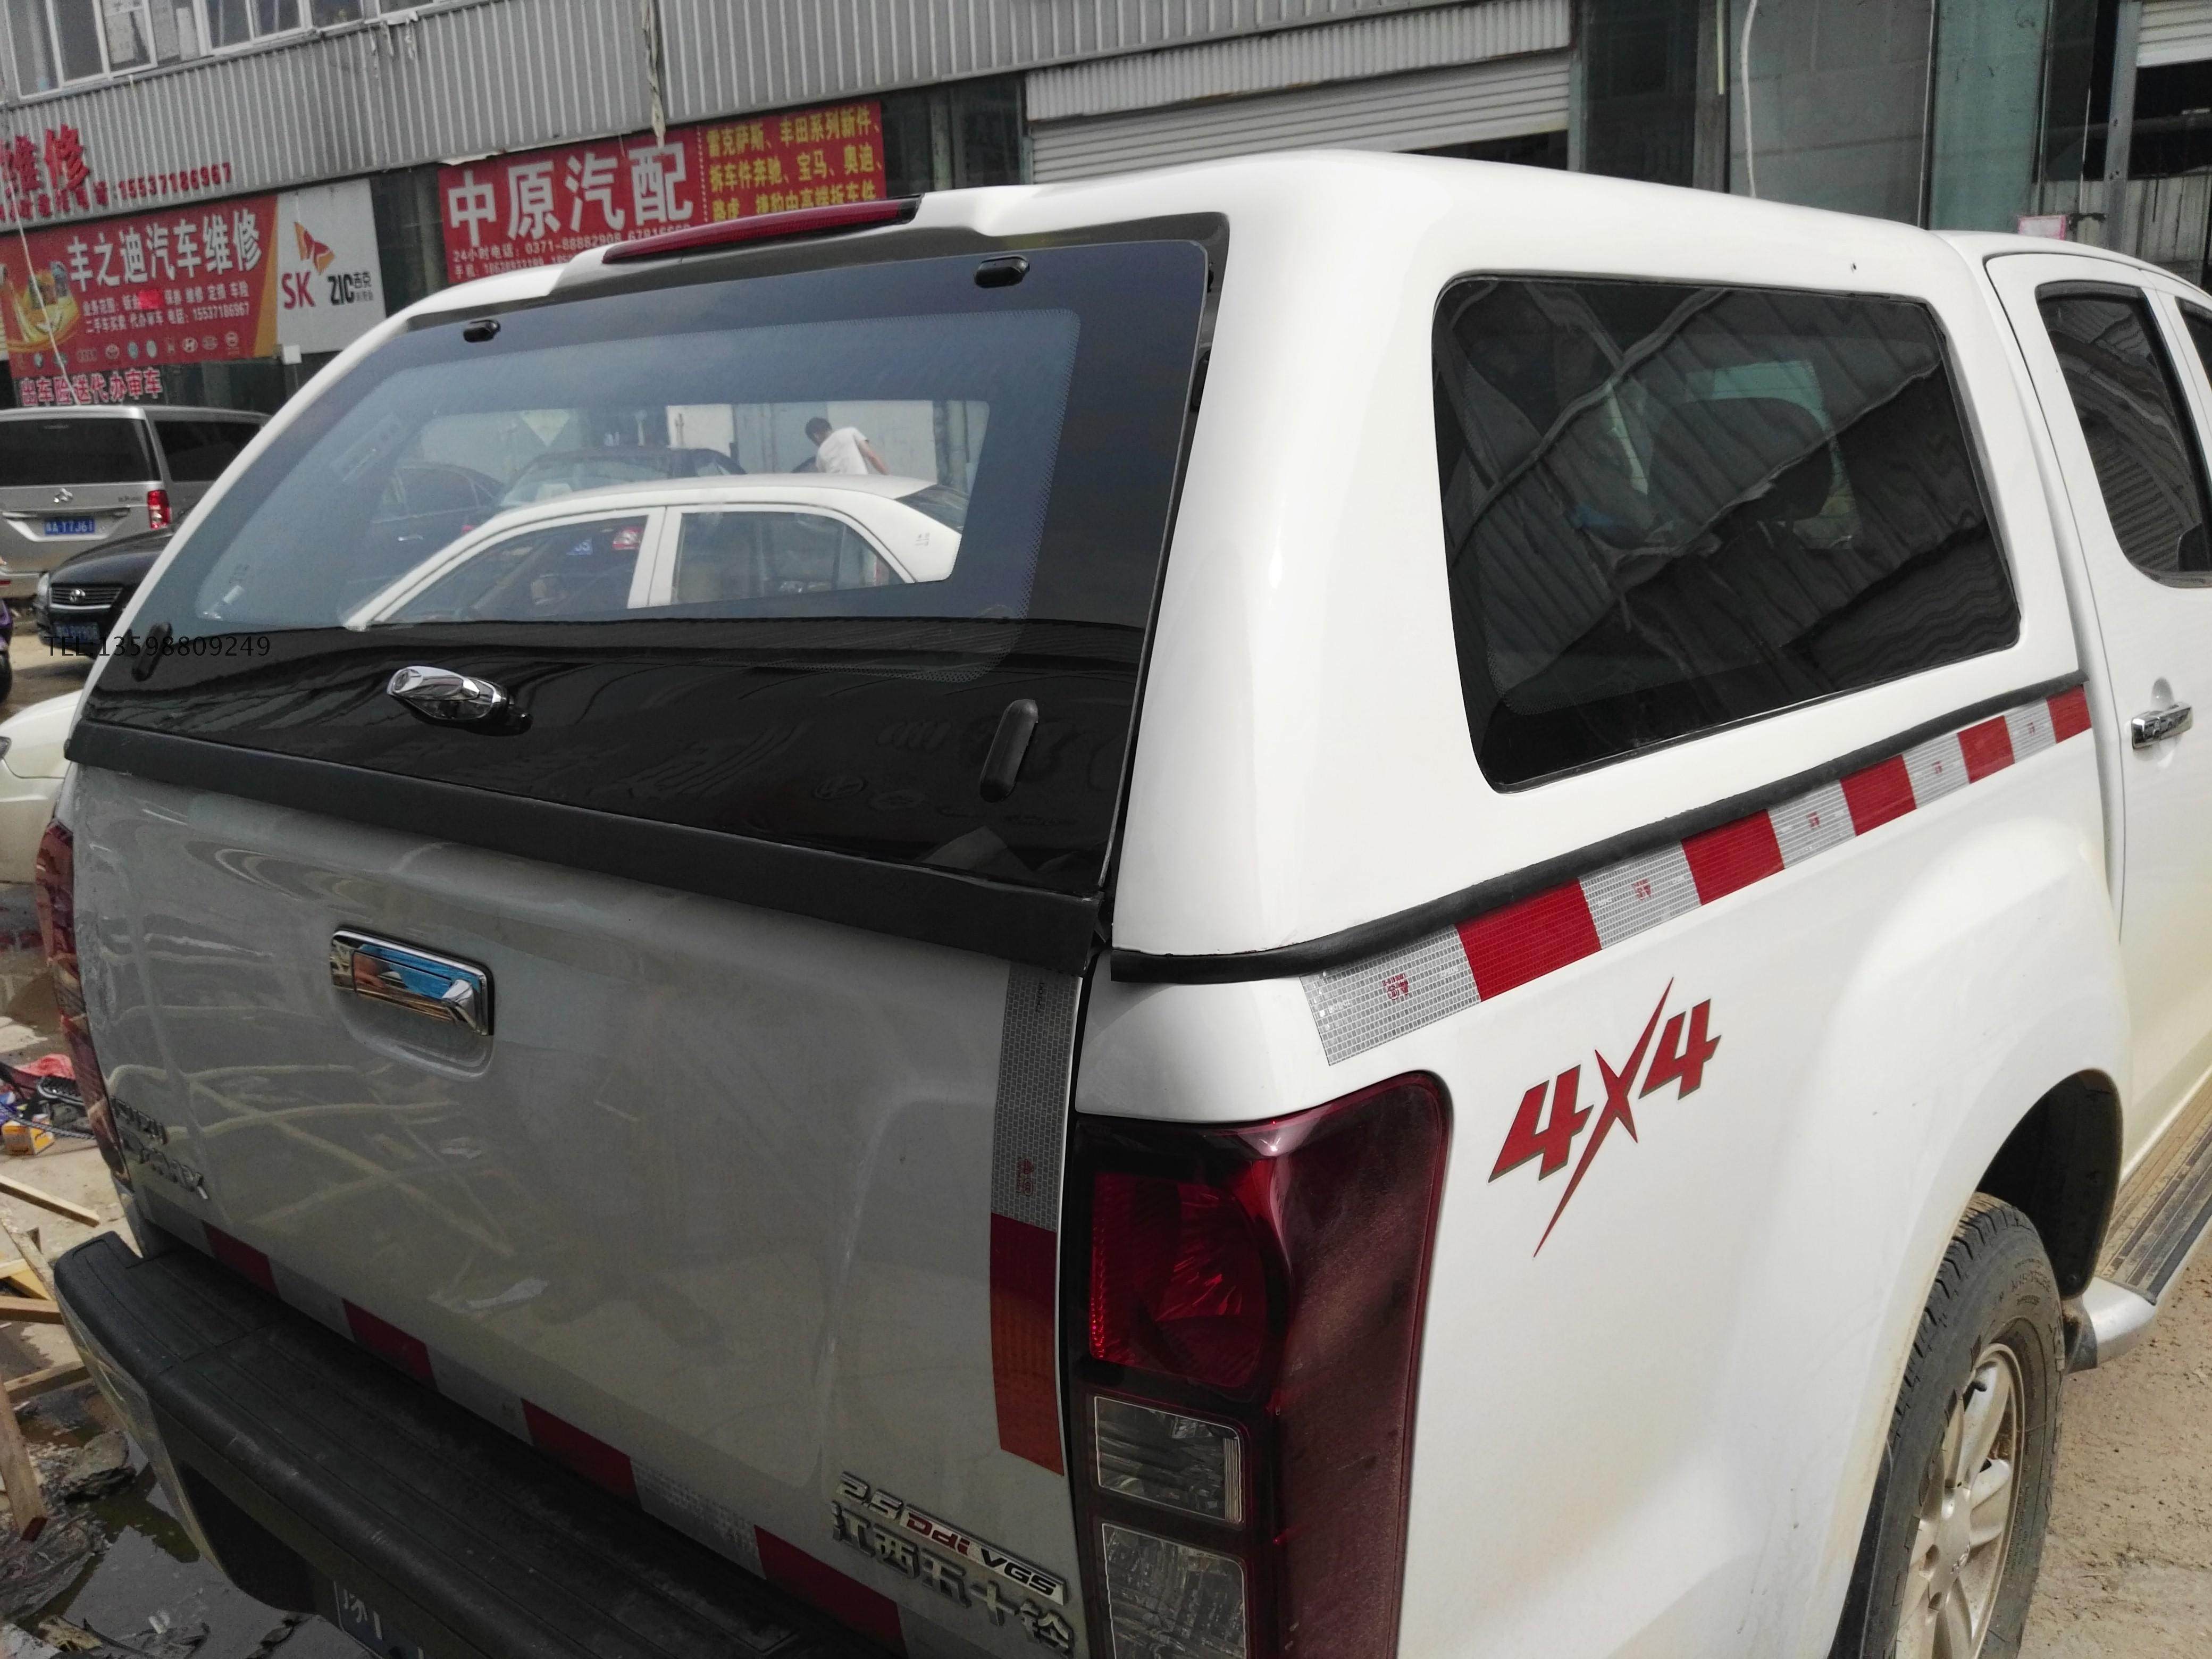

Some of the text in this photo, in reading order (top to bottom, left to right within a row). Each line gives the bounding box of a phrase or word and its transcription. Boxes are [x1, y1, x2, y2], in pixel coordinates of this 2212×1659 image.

[448, 141, 696, 248] 中原汽配
[67, 208, 263, 292] 丰之迪汽车维修
[282, 271, 316, 310] SK
[327, 273, 355, 306] ZIC
[830, 1500, 1074, 1659] 江西五十铃
